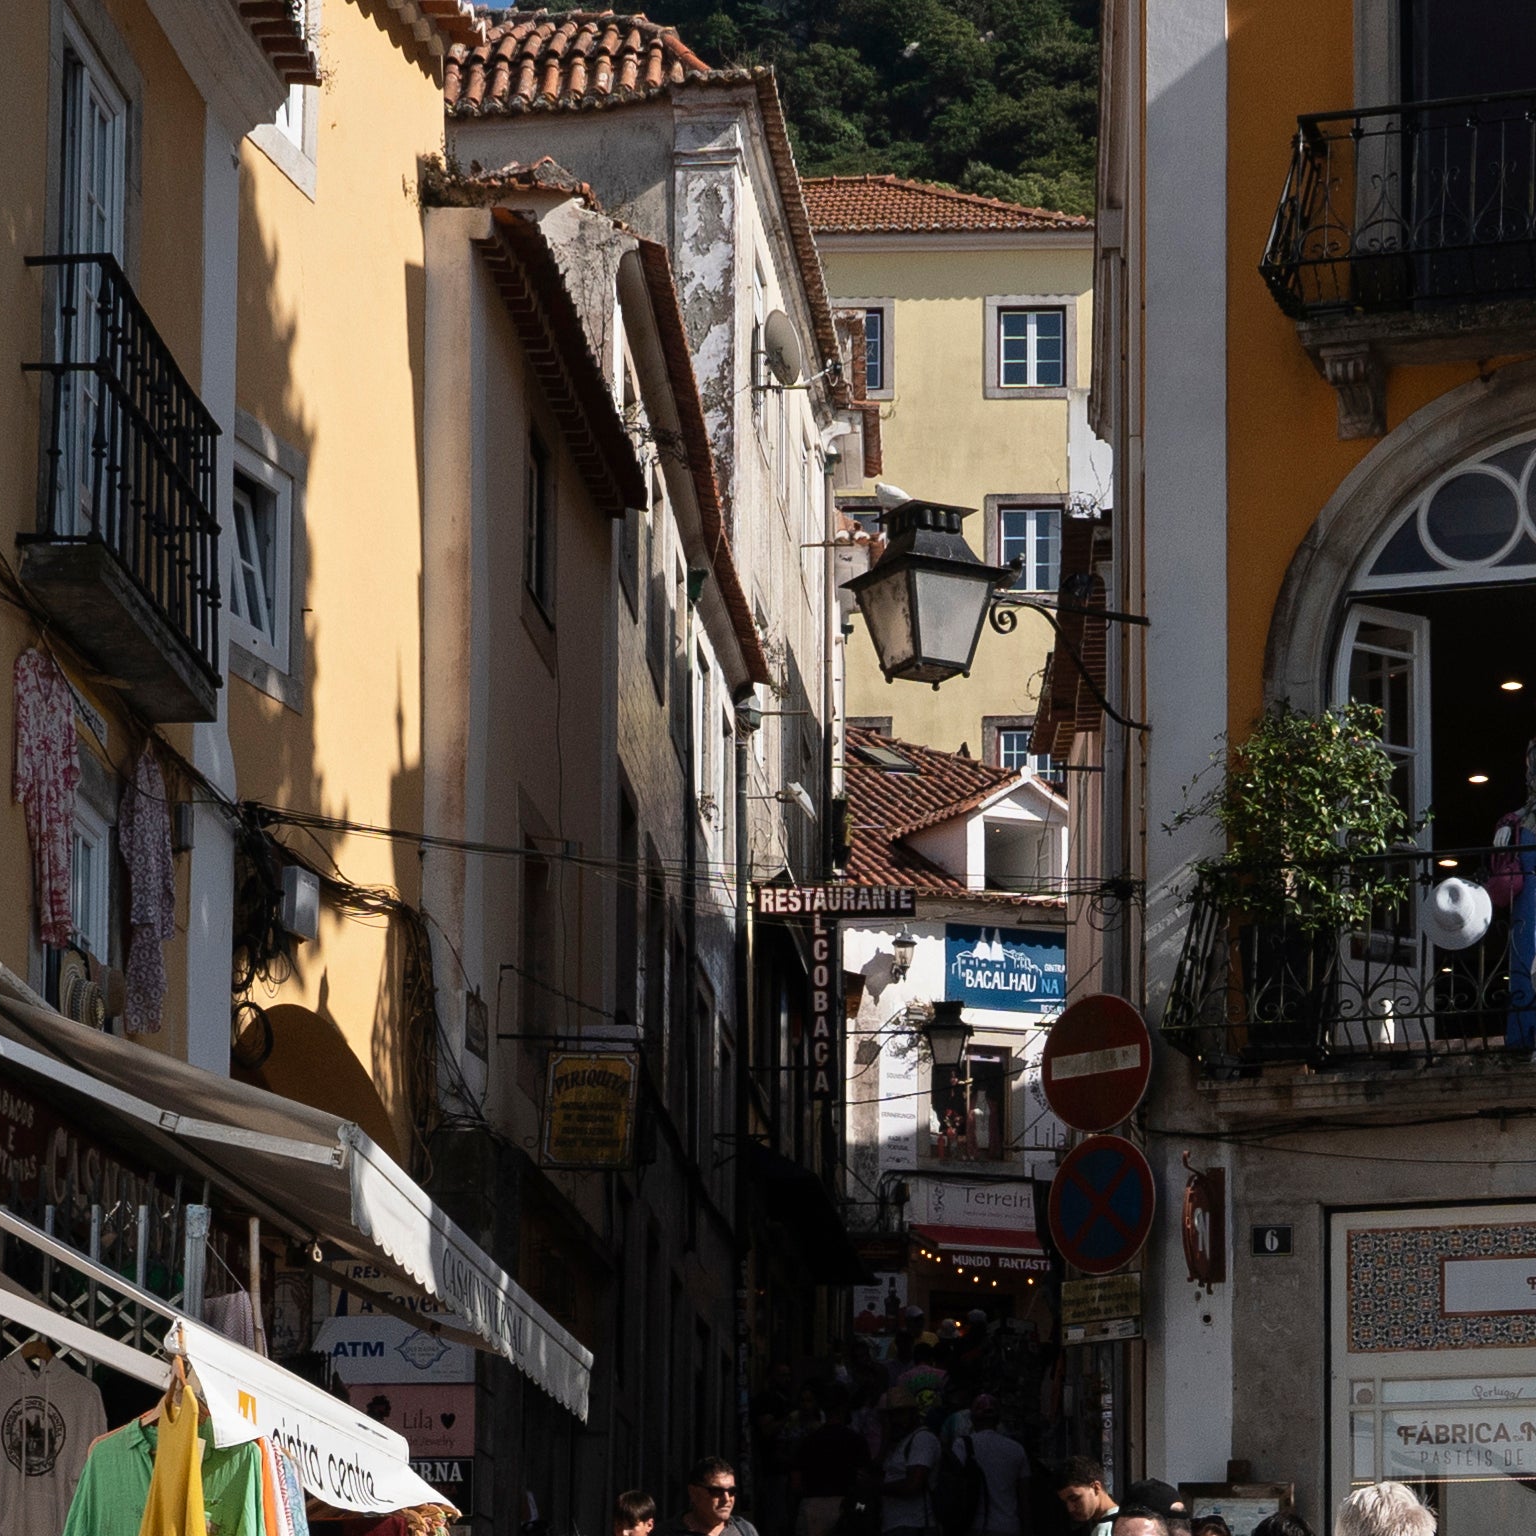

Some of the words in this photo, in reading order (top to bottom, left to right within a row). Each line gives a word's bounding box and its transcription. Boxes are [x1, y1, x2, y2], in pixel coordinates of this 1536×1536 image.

[760, 886, 913, 913] RESTAURANTE
[965, 969, 1037, 993] BACALHAU
[1041, 979, 1060, 995] NA
[962, 1187, 1032, 1209] Terreiri
[1265, 1228, 1279, 1252] 6
[952, 1254, 991, 1268] MUNDO
[332, 1341, 385, 1358] ATM
[1472, 1384, 1524, 1401] Portugal
[402, 1408, 433, 1430] Lila
[1396, 1420, 1511, 1446] FÁBRICA
[1420, 1447, 1493, 1467] PASTÉIS
[1504, 1448, 1524, 1466] DE
